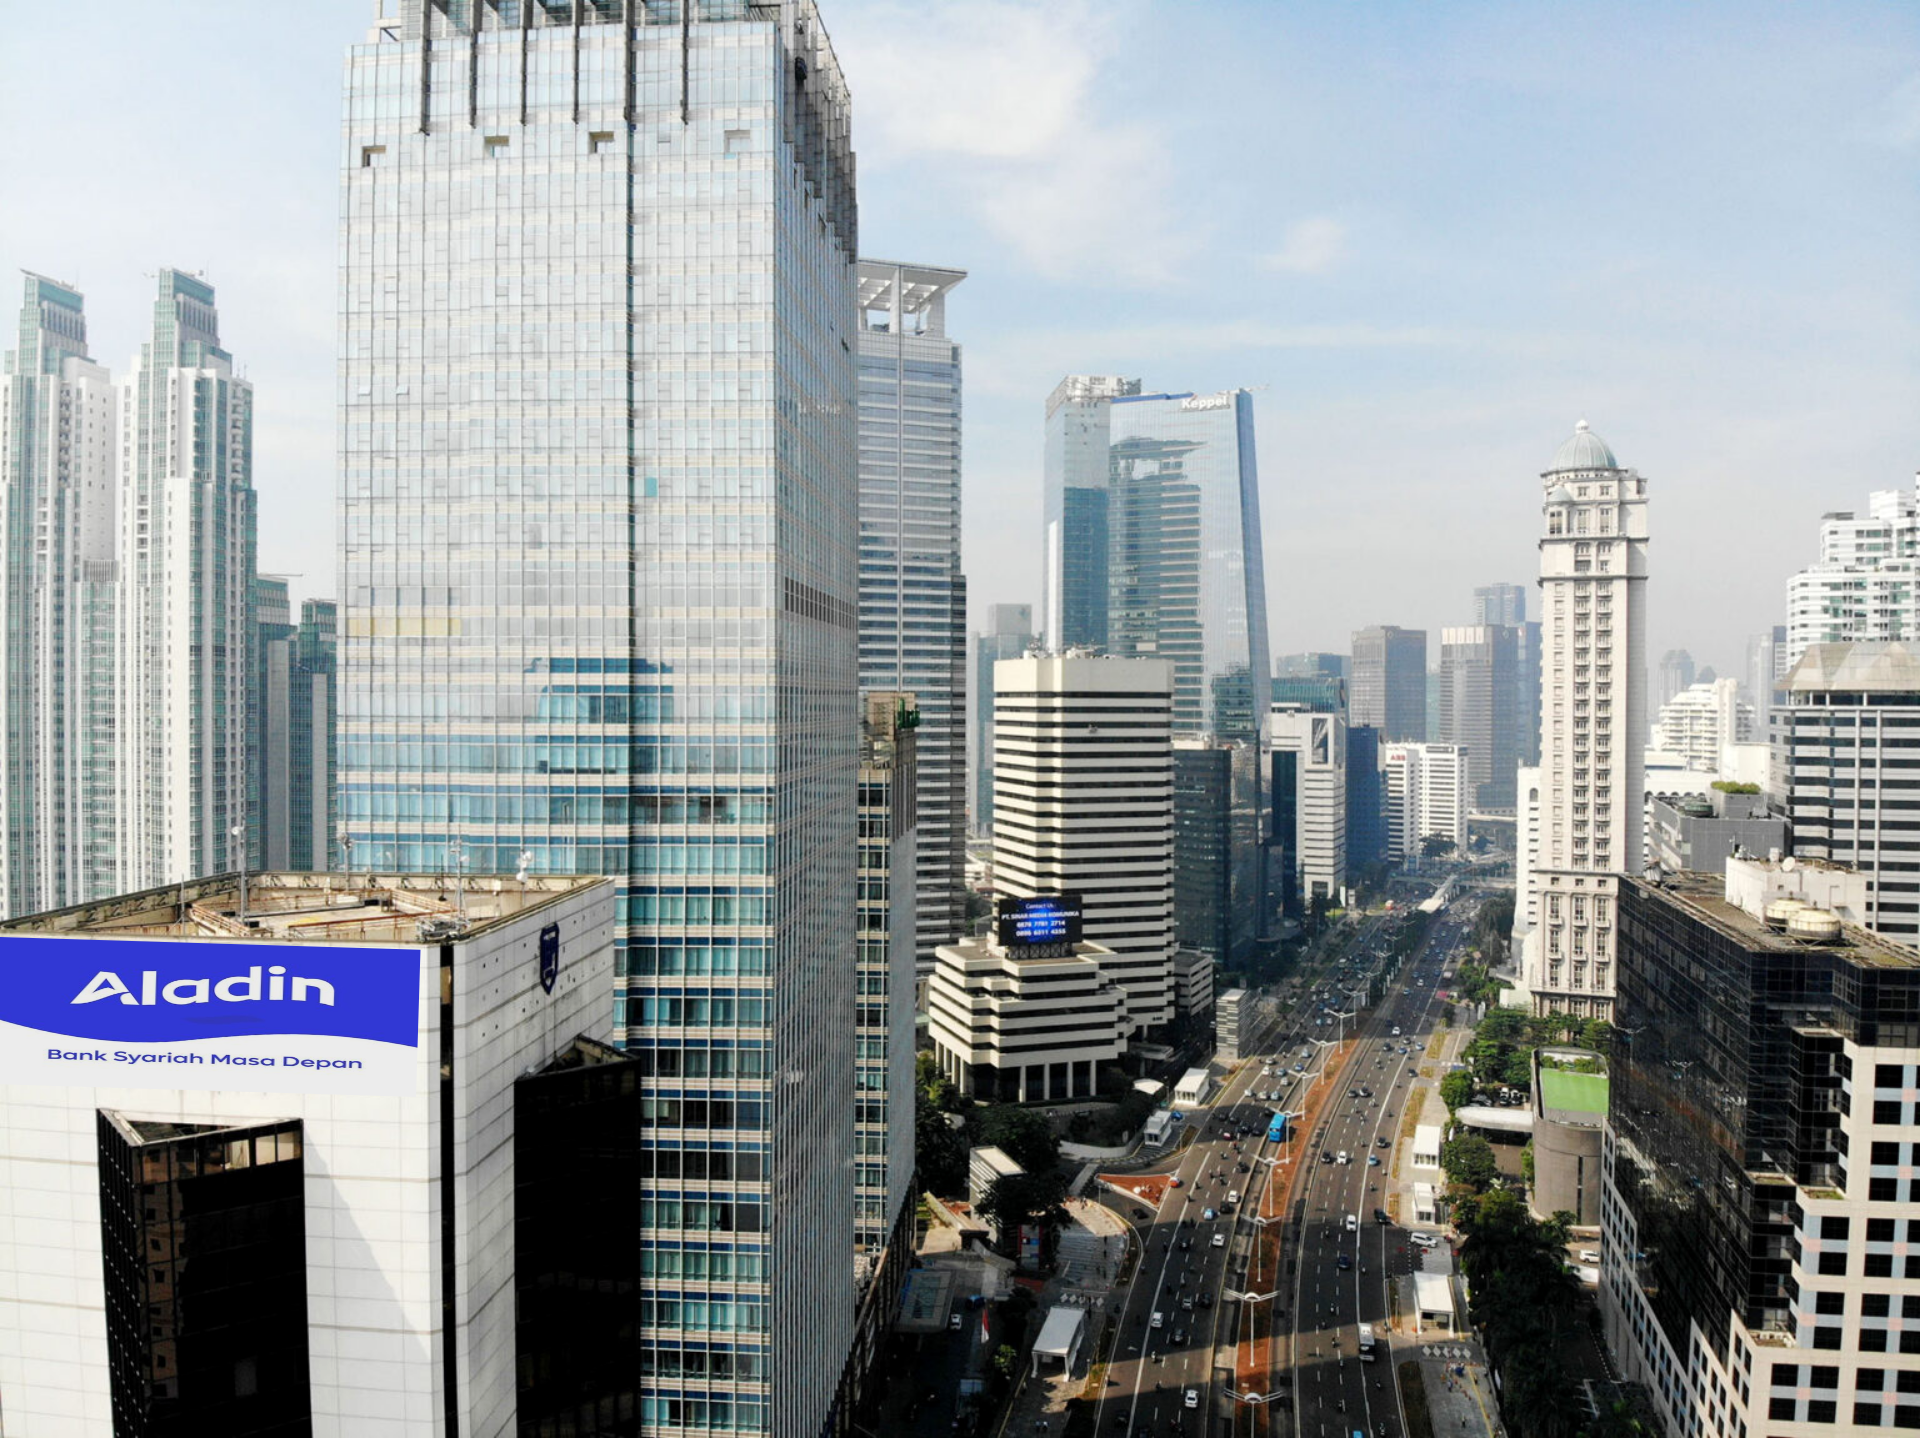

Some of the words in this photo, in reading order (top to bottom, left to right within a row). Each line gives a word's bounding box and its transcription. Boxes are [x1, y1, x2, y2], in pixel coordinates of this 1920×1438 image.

[1181, 395, 1227, 410] Keppel
[71, 966, 335, 1006] Aladin
[47, 1049, 107, 1062] Bank
[113, 1051, 204, 1067] Syariah
[210, 1054, 276, 1067] Masa
[283, 1056, 363, 1071] Depan
